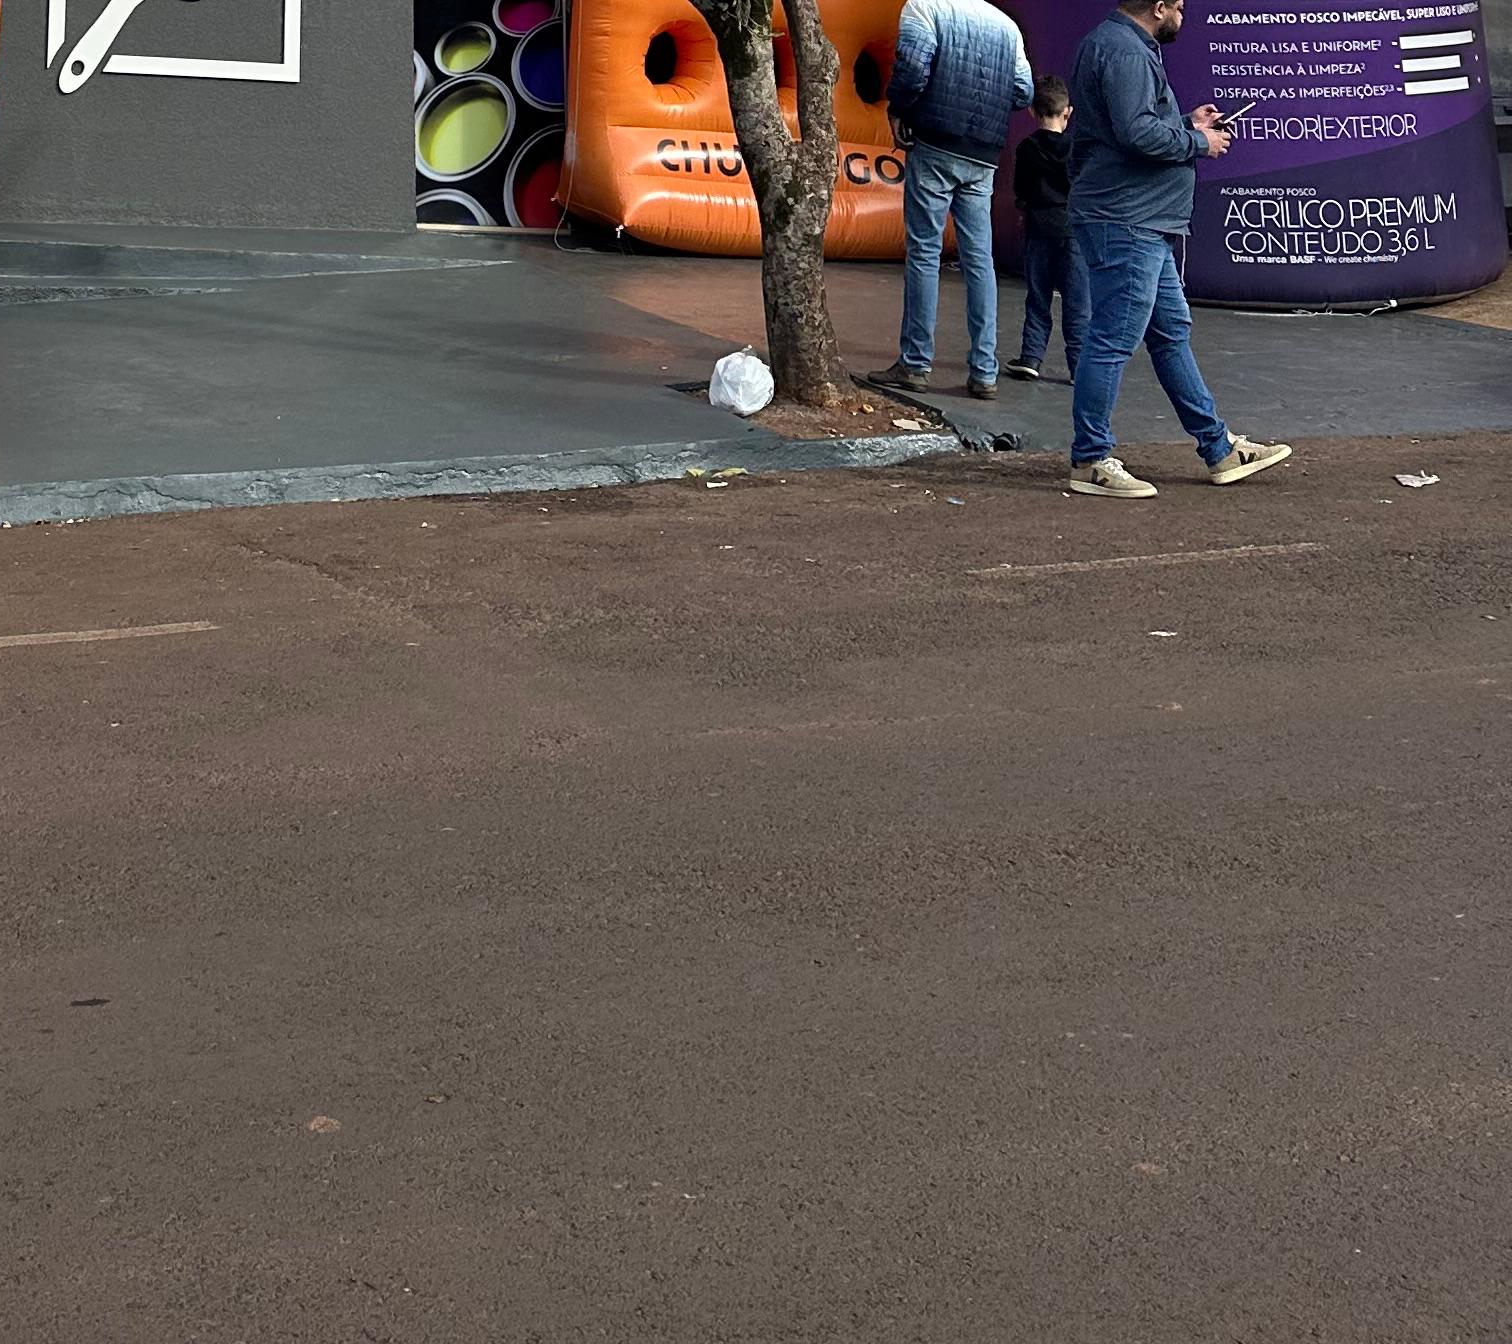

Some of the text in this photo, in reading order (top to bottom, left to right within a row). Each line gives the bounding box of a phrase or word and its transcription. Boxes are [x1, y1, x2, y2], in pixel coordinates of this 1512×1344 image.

[1206, 13, 1296, 25] ACABAMENTO
[1300, 12, 1340, 24] FOSCO
[1406, 7, 1435, 20] SUPER
[1209, 41, 1268, 54] PINTURA
[1272, 41, 1298, 54] LISA
[1302, 41, 1310, 53] E
[1212, 63, 1294, 76] RESISTÊNCIA
[1213, 87, 1276, 101] DISFARÇA
[1279, 87, 1296, 99] AS
[657, 139, 743, 177] CHU
[1220, 187, 1317, 197] ACABAMENTO FOSCO
[1224, 192, 1458, 229] ACRÍLICO PREMIUM
[1225, 228, 1383, 255] CONTEÚDO
[1424, 227, 1436, 250] L
[1231, 253, 1255, 263] Uma
[1257, 255, 1287, 264] marca
[1289, 254, 1316, 264] BASF
[1324, 255, 1337, 264] We
[1338, 255, 1362, 264] create
